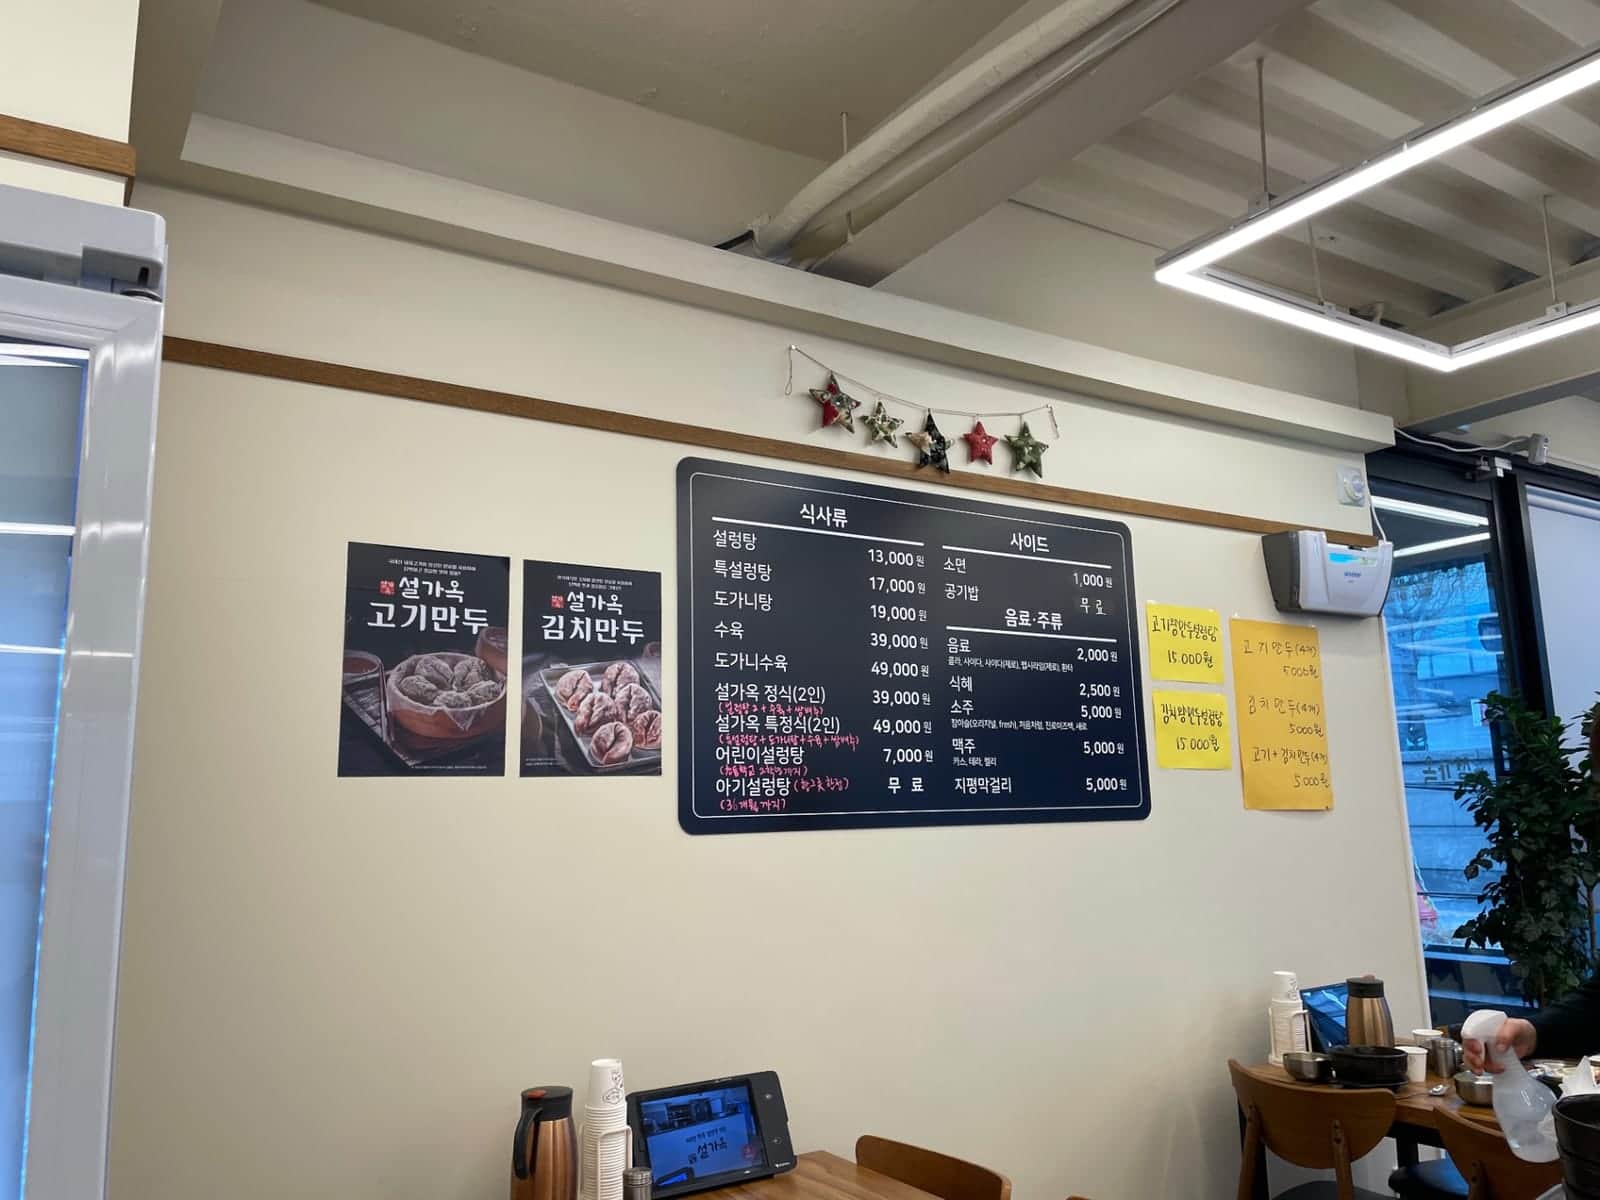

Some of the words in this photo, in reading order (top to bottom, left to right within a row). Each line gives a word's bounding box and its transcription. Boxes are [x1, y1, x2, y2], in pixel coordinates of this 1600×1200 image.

[799, 504, 849, 528] 식사류
[713, 530, 758, 552] 설렁탕
[1010, 532, 1050, 553] 사이드
[868, 548, 914, 567] 13,000
[916, 555, 925, 568] 원
[943, 557, 967, 574] 소면
[713, 559, 772, 582] 특설렁탕
[868, 576, 915, 594] 17,000
[917, 583, 926, 594] 원
[1074, 572, 1104, 588] 1,000
[1106, 577, 1113, 588] 원
[399, 577, 464, 602] 설가옥
[944, 583, 979, 602] 공기밥
[566, 592, 624, 616] 설가옥
[714, 590, 773, 612] 도가니탕
[367, 603, 490, 634] 고기만두
[870, 604, 916, 622] 19,000
[918, 610, 928, 622] 원
[540, 615, 645, 645] 김치만두
[714, 620, 744, 640] 수육
[870, 633, 917, 650] 39,000
[920, 638, 928, 650] 원
[946, 637, 972, 654] 음료
[714, 652, 788, 672] 도가니수육
[1076, 648, 1109, 662] 2,000
[1110, 651, 1118, 662] 원
[871, 661, 918, 678] 49,000
[920, 665, 930, 678] 원
[714, 682, 760, 702] 설가옥
[764, 684, 826, 704] 정식(2인)
[949, 676, 973, 692] 식혜
[1080, 683, 1111, 698] 2,500
[1112, 686, 1121, 698] 원
[872, 690, 920, 706] 39,000
[922, 694, 931, 706] 원
[950, 700, 974, 716] 소주
[1080, 705, 1112, 720] 5,000
[1114, 708, 1122, 719] 원
[716, 714, 760, 733] 설가옥
[764, 716, 840, 735] 특정식(2인)
[873, 720, 921, 735] 49,000
[923, 722, 932, 734] 원
[952, 737, 976, 754] 맥주
[1083, 741, 1115, 756] 5,000
[1117, 743, 1125, 754] 원
[716, 746, 805, 766] 어린이설렁탕
[883, 748, 922, 764] 7,000
[924, 749, 934, 763] 원
[716, 778, 791, 797] 아기설렁탕
[954, 776, 1012, 795] 지평막걸리
[1086, 777, 1118, 792] 5,000
[1119, 778, 1127, 791] 원
